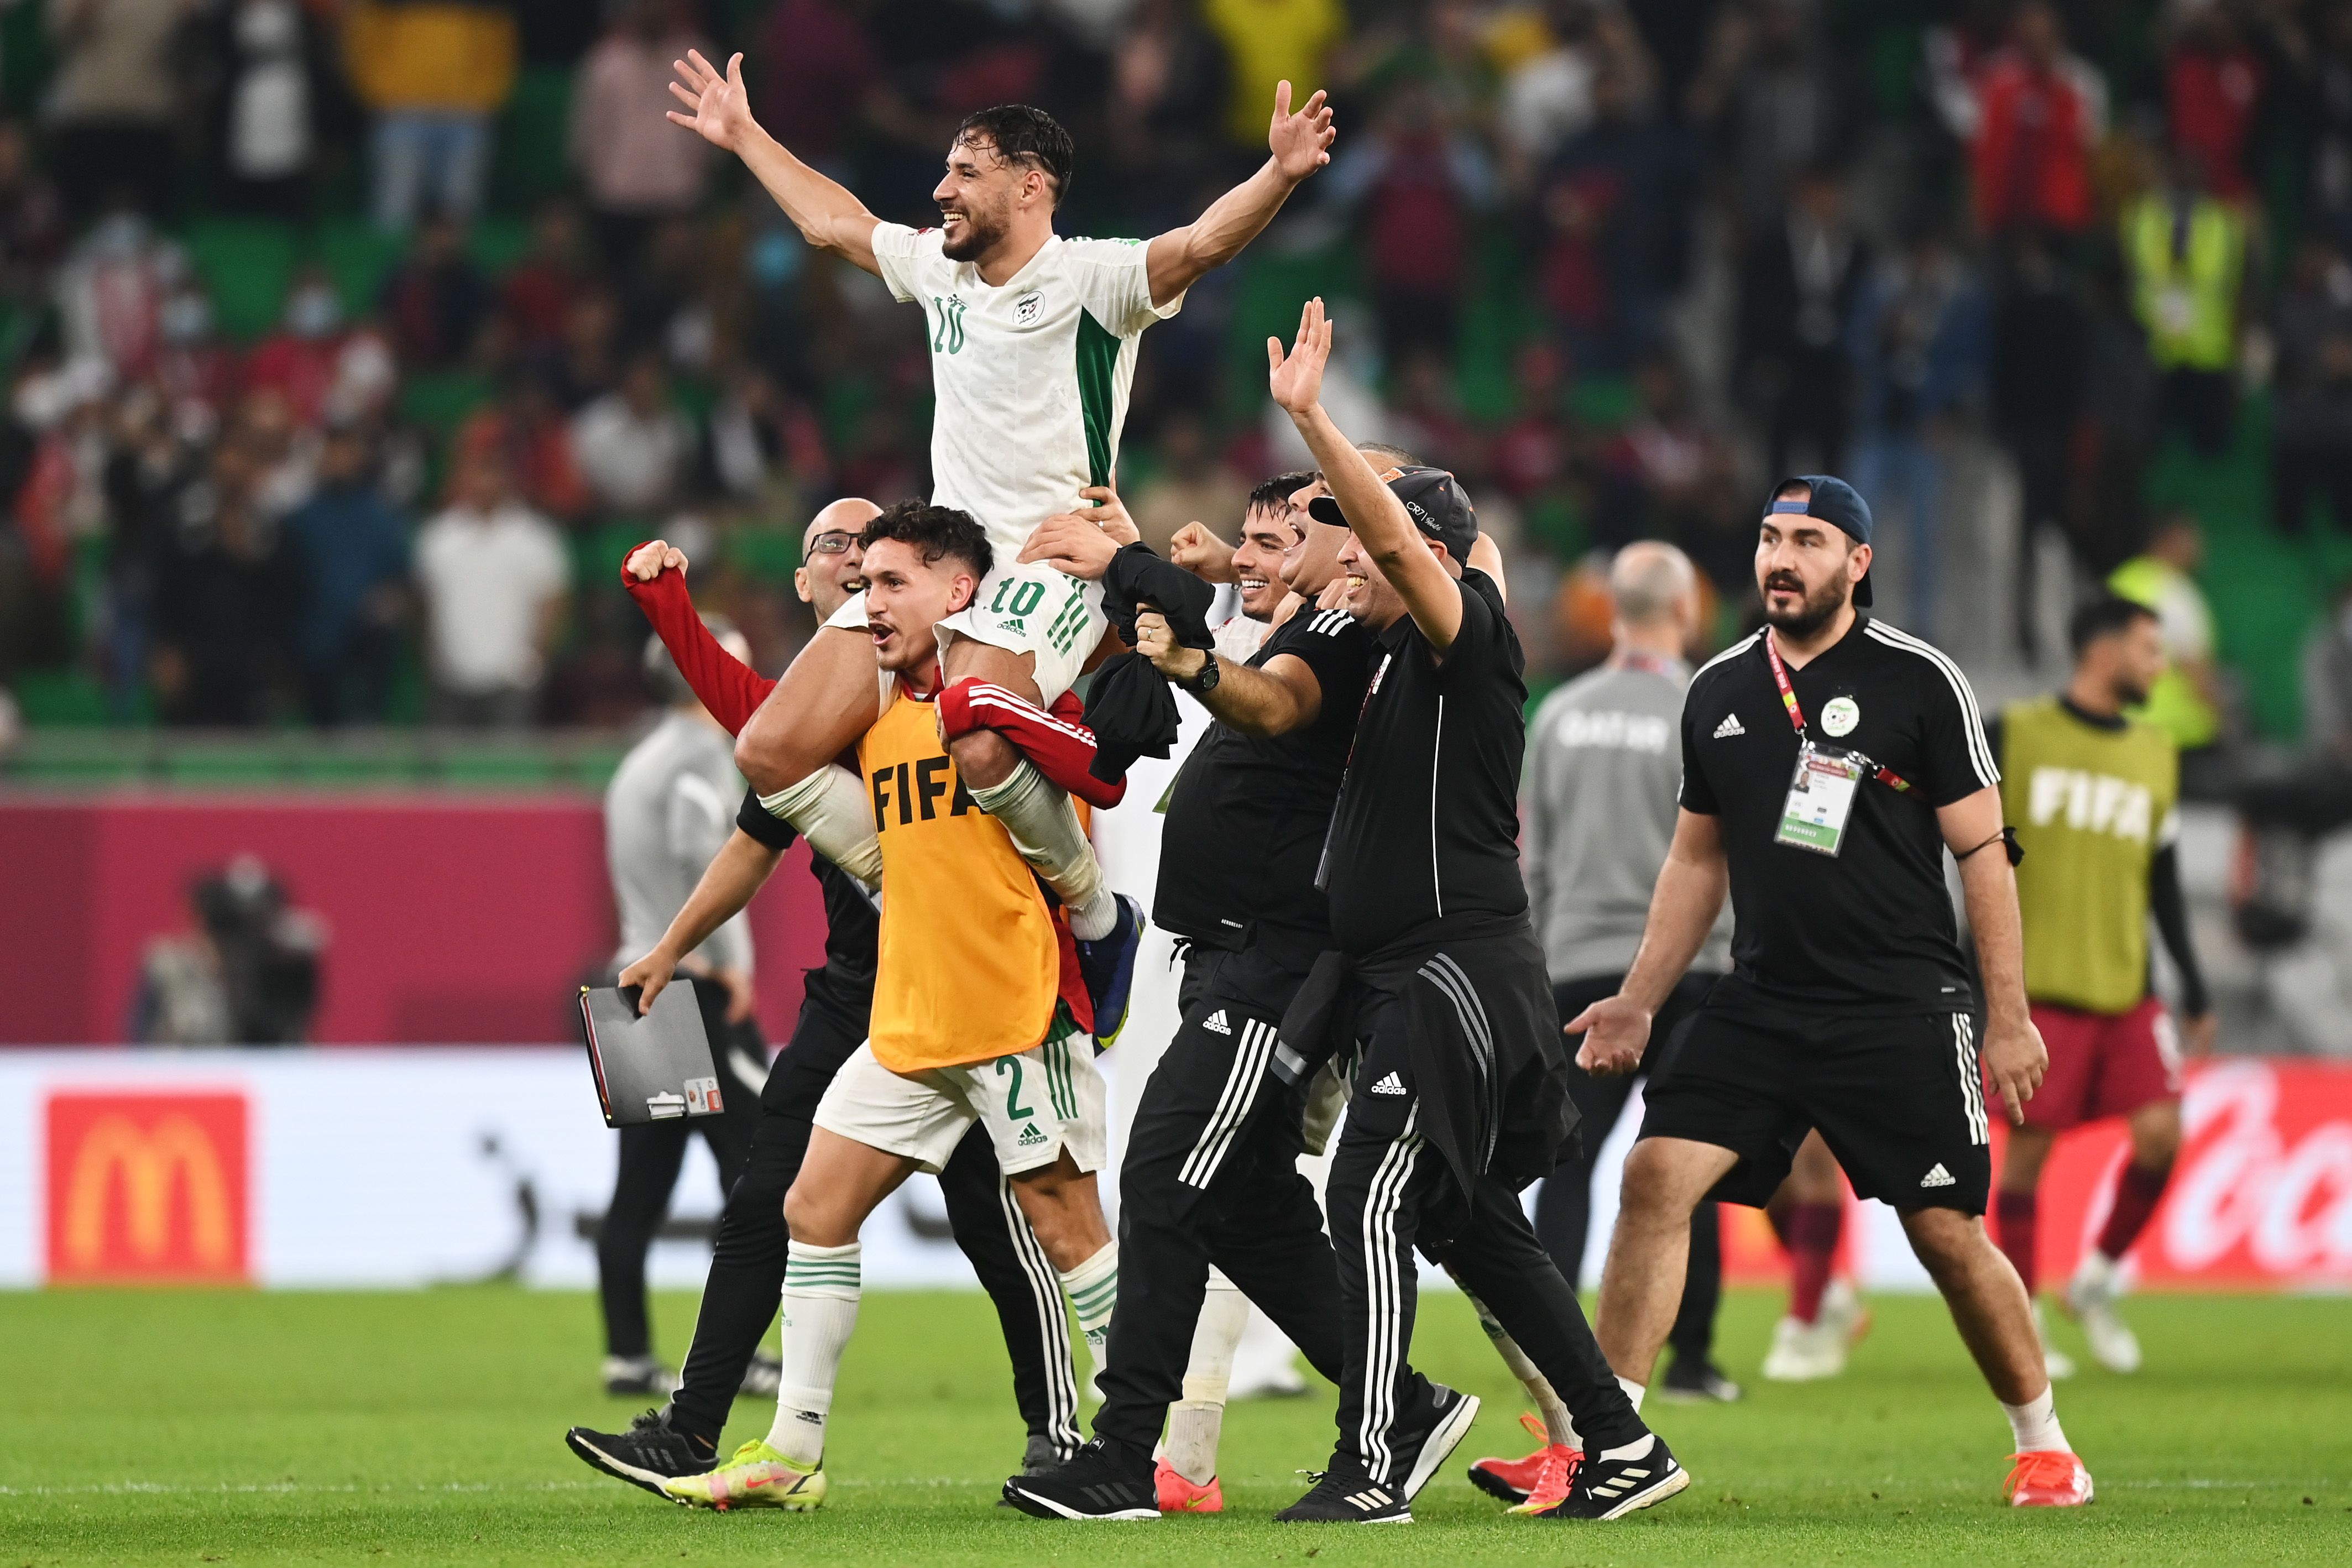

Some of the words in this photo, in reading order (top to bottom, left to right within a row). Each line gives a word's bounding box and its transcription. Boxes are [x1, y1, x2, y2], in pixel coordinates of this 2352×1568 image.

[934, 296, 967, 354] 10
[1406, 501, 1425, 516] CR7
[990, 577, 1046, 616] 10
[997, 623, 1027, 637] adidas
[1713, 726, 1745, 739] adidas
[2029, 767, 2152, 845] FIFA
[1203, 1021, 1231, 1036] adidas
[996, 1055, 1034, 1121] 2
[1371, 1084, 1407, 1095] adidas
[1018, 1135, 1048, 1146] adidas
[1920, 1175, 1956, 1188] adidas
